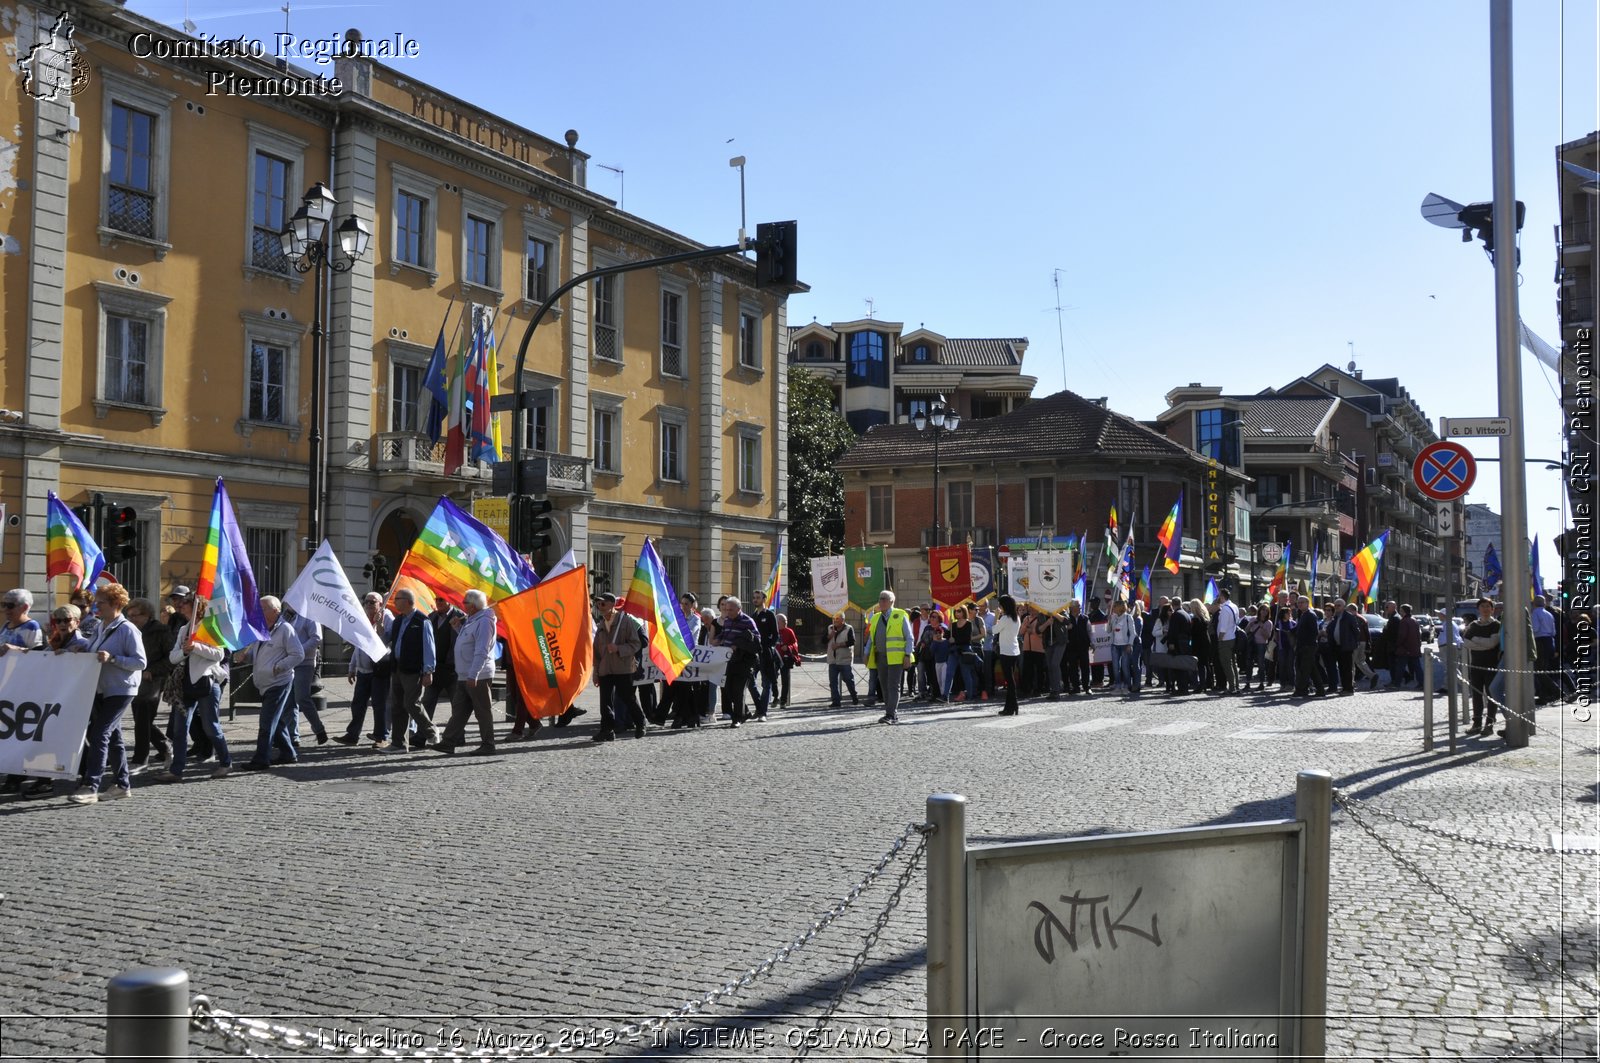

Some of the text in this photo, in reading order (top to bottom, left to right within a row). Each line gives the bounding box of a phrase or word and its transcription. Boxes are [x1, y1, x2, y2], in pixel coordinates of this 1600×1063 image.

[411, 94, 531, 164] MUNICIPIO
[1464, 426, 1473, 435] Di
[1476, 426, 1507, 435] Vittorio
[477, 508, 509, 519] TEATR
[1008, 536, 1047, 544] ORTOPEA
[310, 592, 356, 625] NICHELINO
[546, 631, 566, 672] auser
